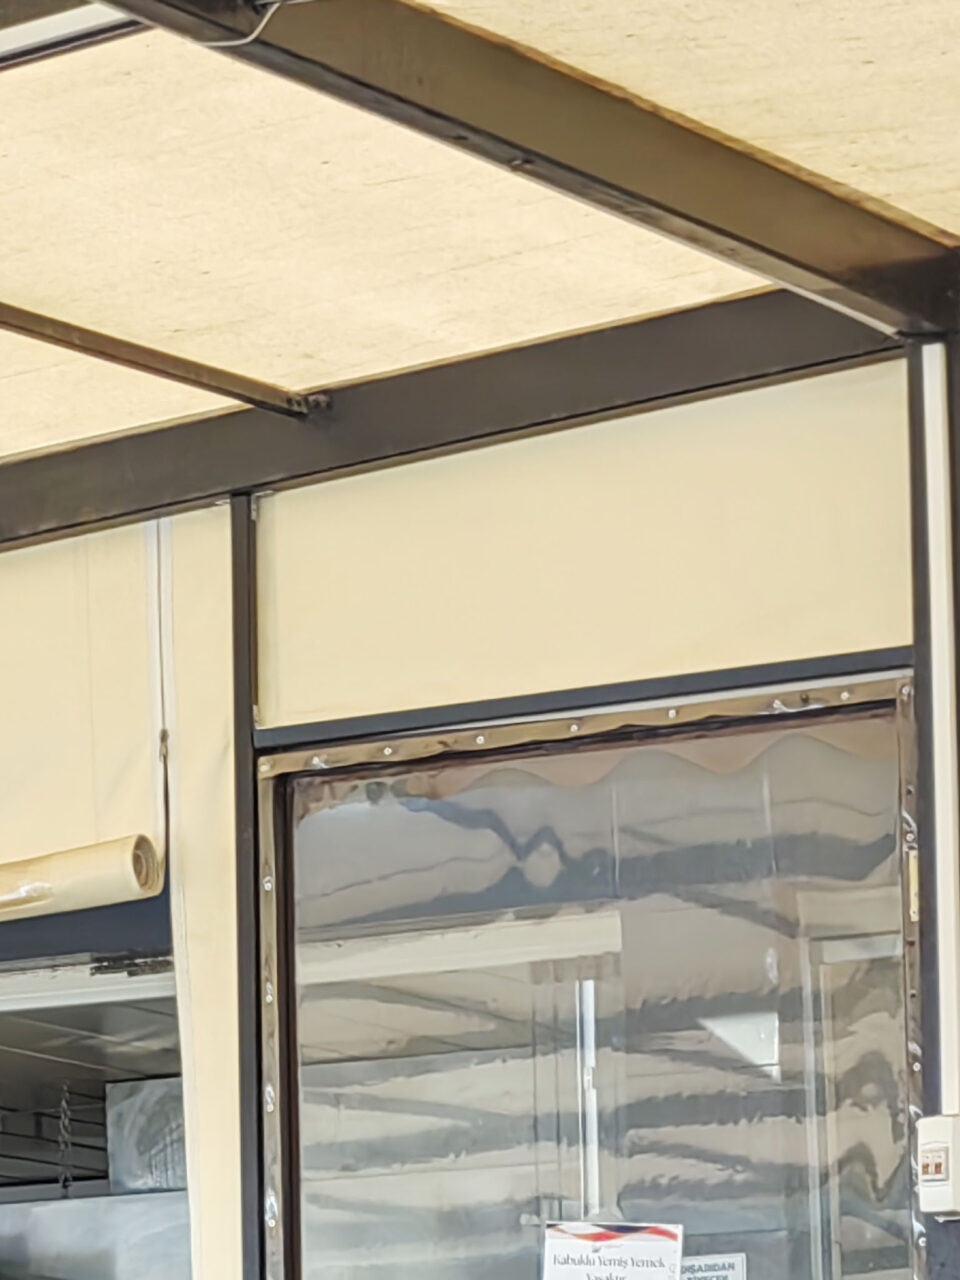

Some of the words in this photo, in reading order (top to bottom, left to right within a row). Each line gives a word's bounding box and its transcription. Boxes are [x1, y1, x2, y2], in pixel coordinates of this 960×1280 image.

[553, 1253, 595, 1266] Kabuklu
[598, 1255, 629, 1269] Yemiş
[630, 1256, 666, 1268] Yemek
